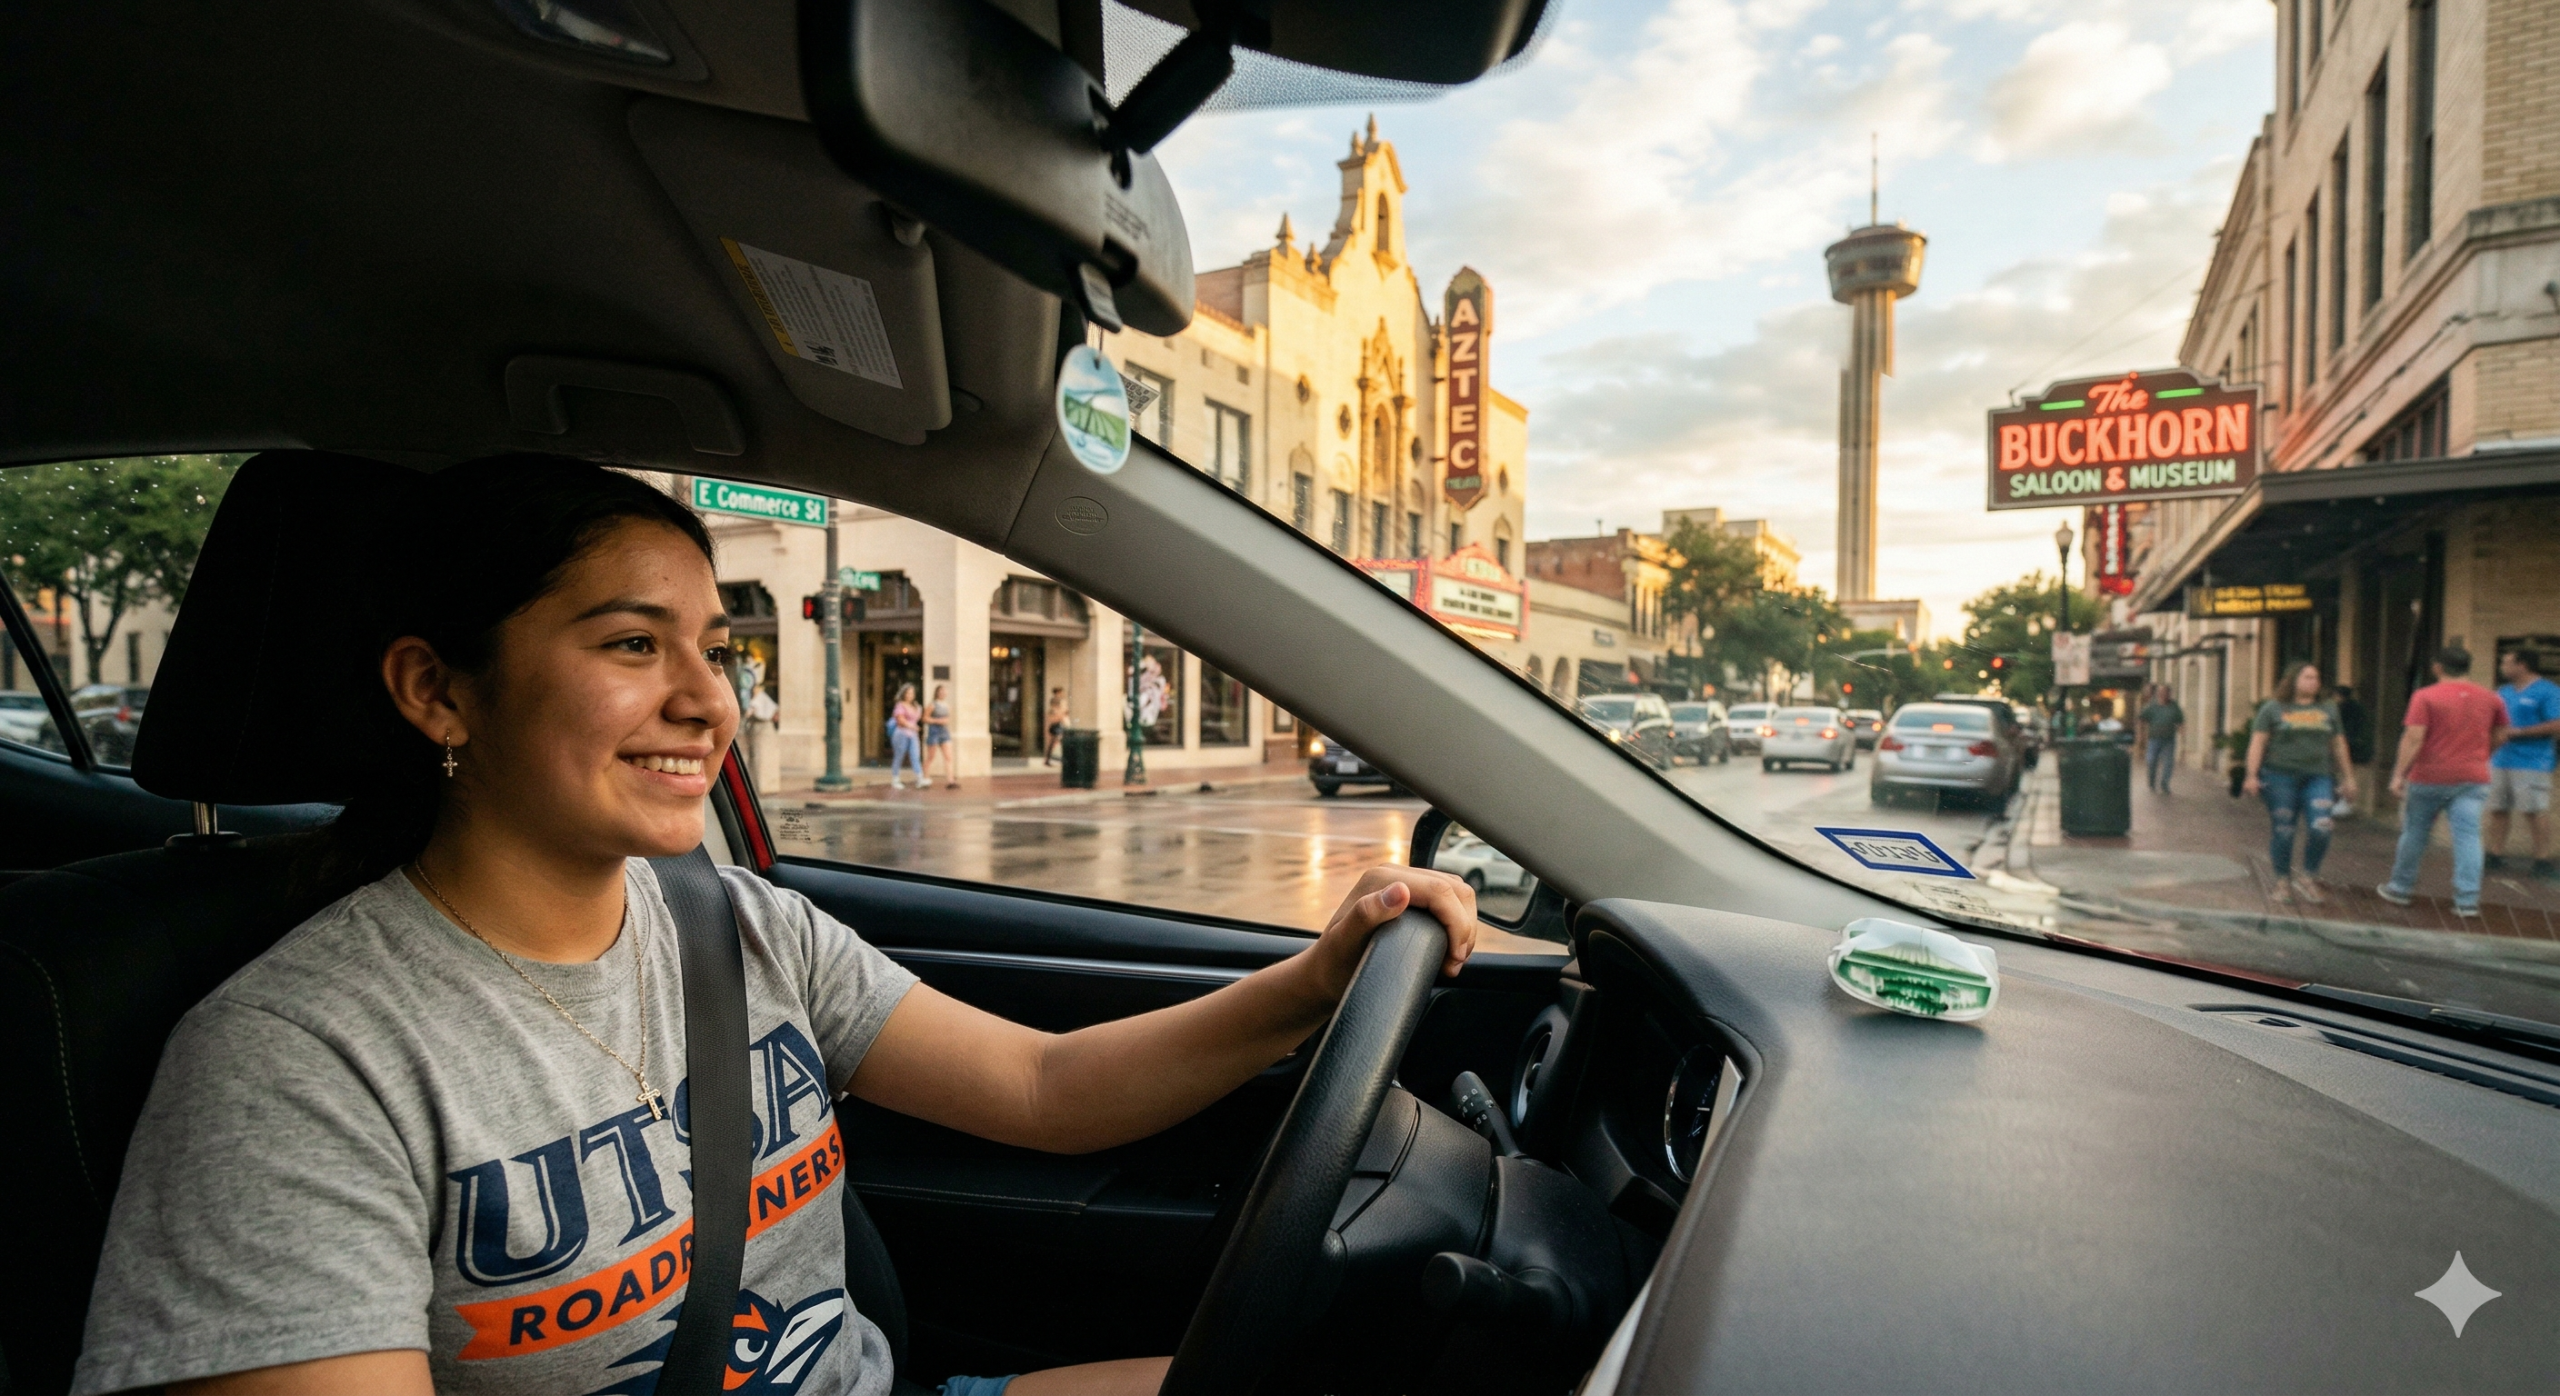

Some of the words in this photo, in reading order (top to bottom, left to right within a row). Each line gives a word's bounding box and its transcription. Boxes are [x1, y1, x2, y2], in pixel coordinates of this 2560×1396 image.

[1450, 298, 1480, 470] AZTEC
[2088, 376, 2149, 415] The
[1999, 403, 2249, 470] BUCKHORN
[699, 481, 712, 506] E
[716, 484, 800, 518] Commerce
[804, 498, 821, 521] St
[2010, 468, 2101, 498] SALOON
[2105, 466, 2126, 492] &
[2129, 458, 2237, 489] MUSEUM
[509, 1133, 840, 1346] ROADRNERS
